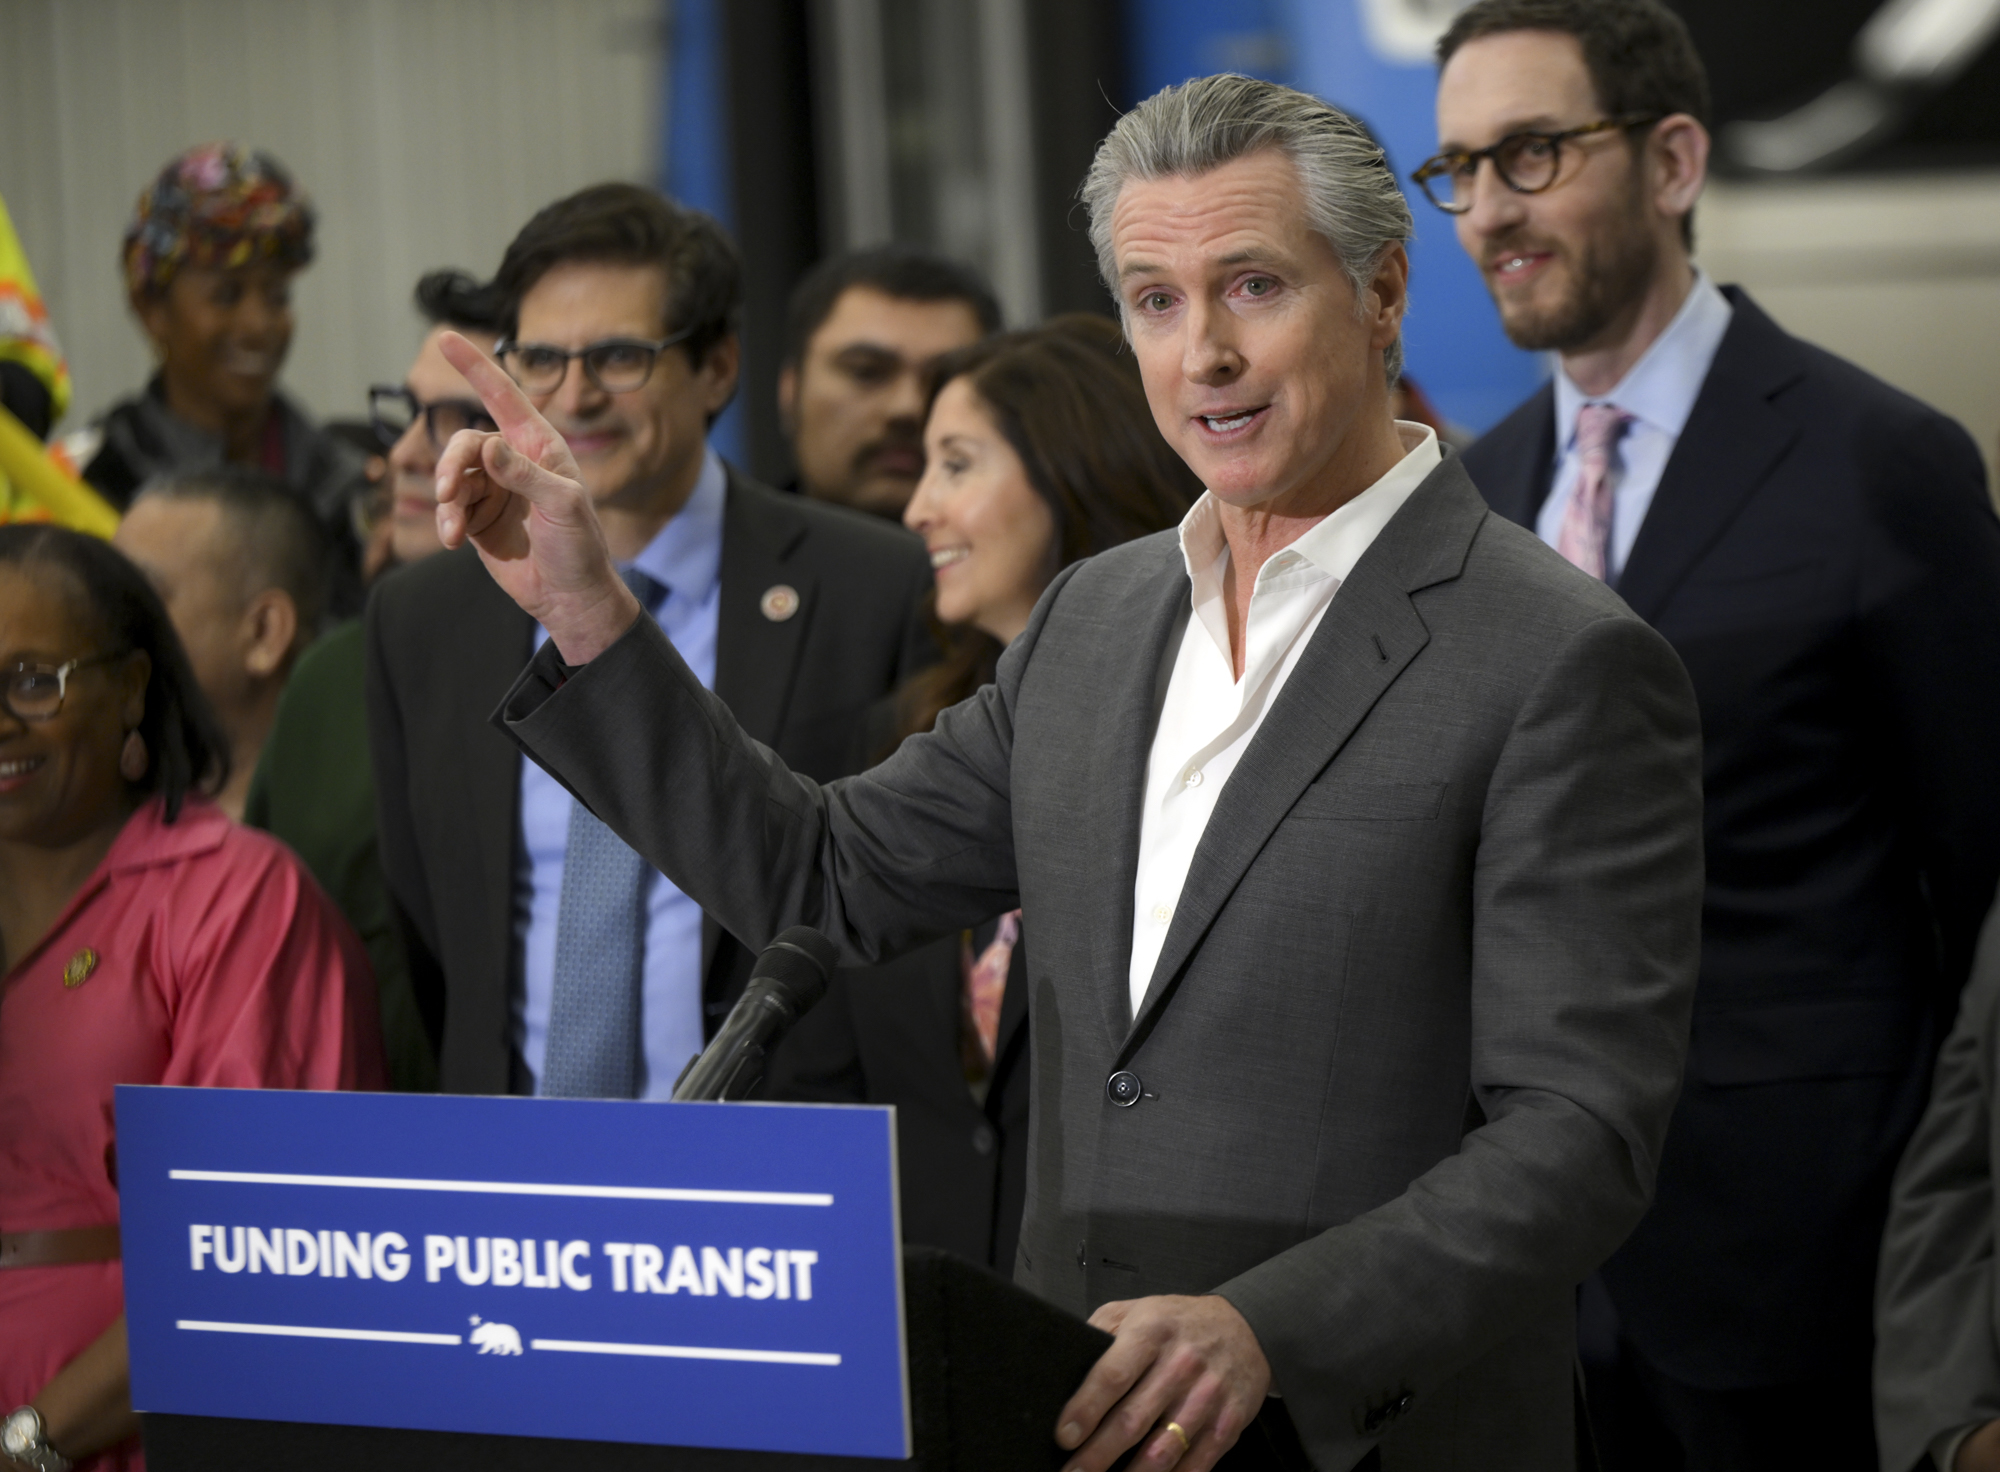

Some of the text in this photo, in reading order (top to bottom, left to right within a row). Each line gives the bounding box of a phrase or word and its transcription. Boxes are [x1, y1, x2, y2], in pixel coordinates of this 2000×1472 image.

[189, 1224, 818, 1301] FUNDING PUBLIC TRANSIT
